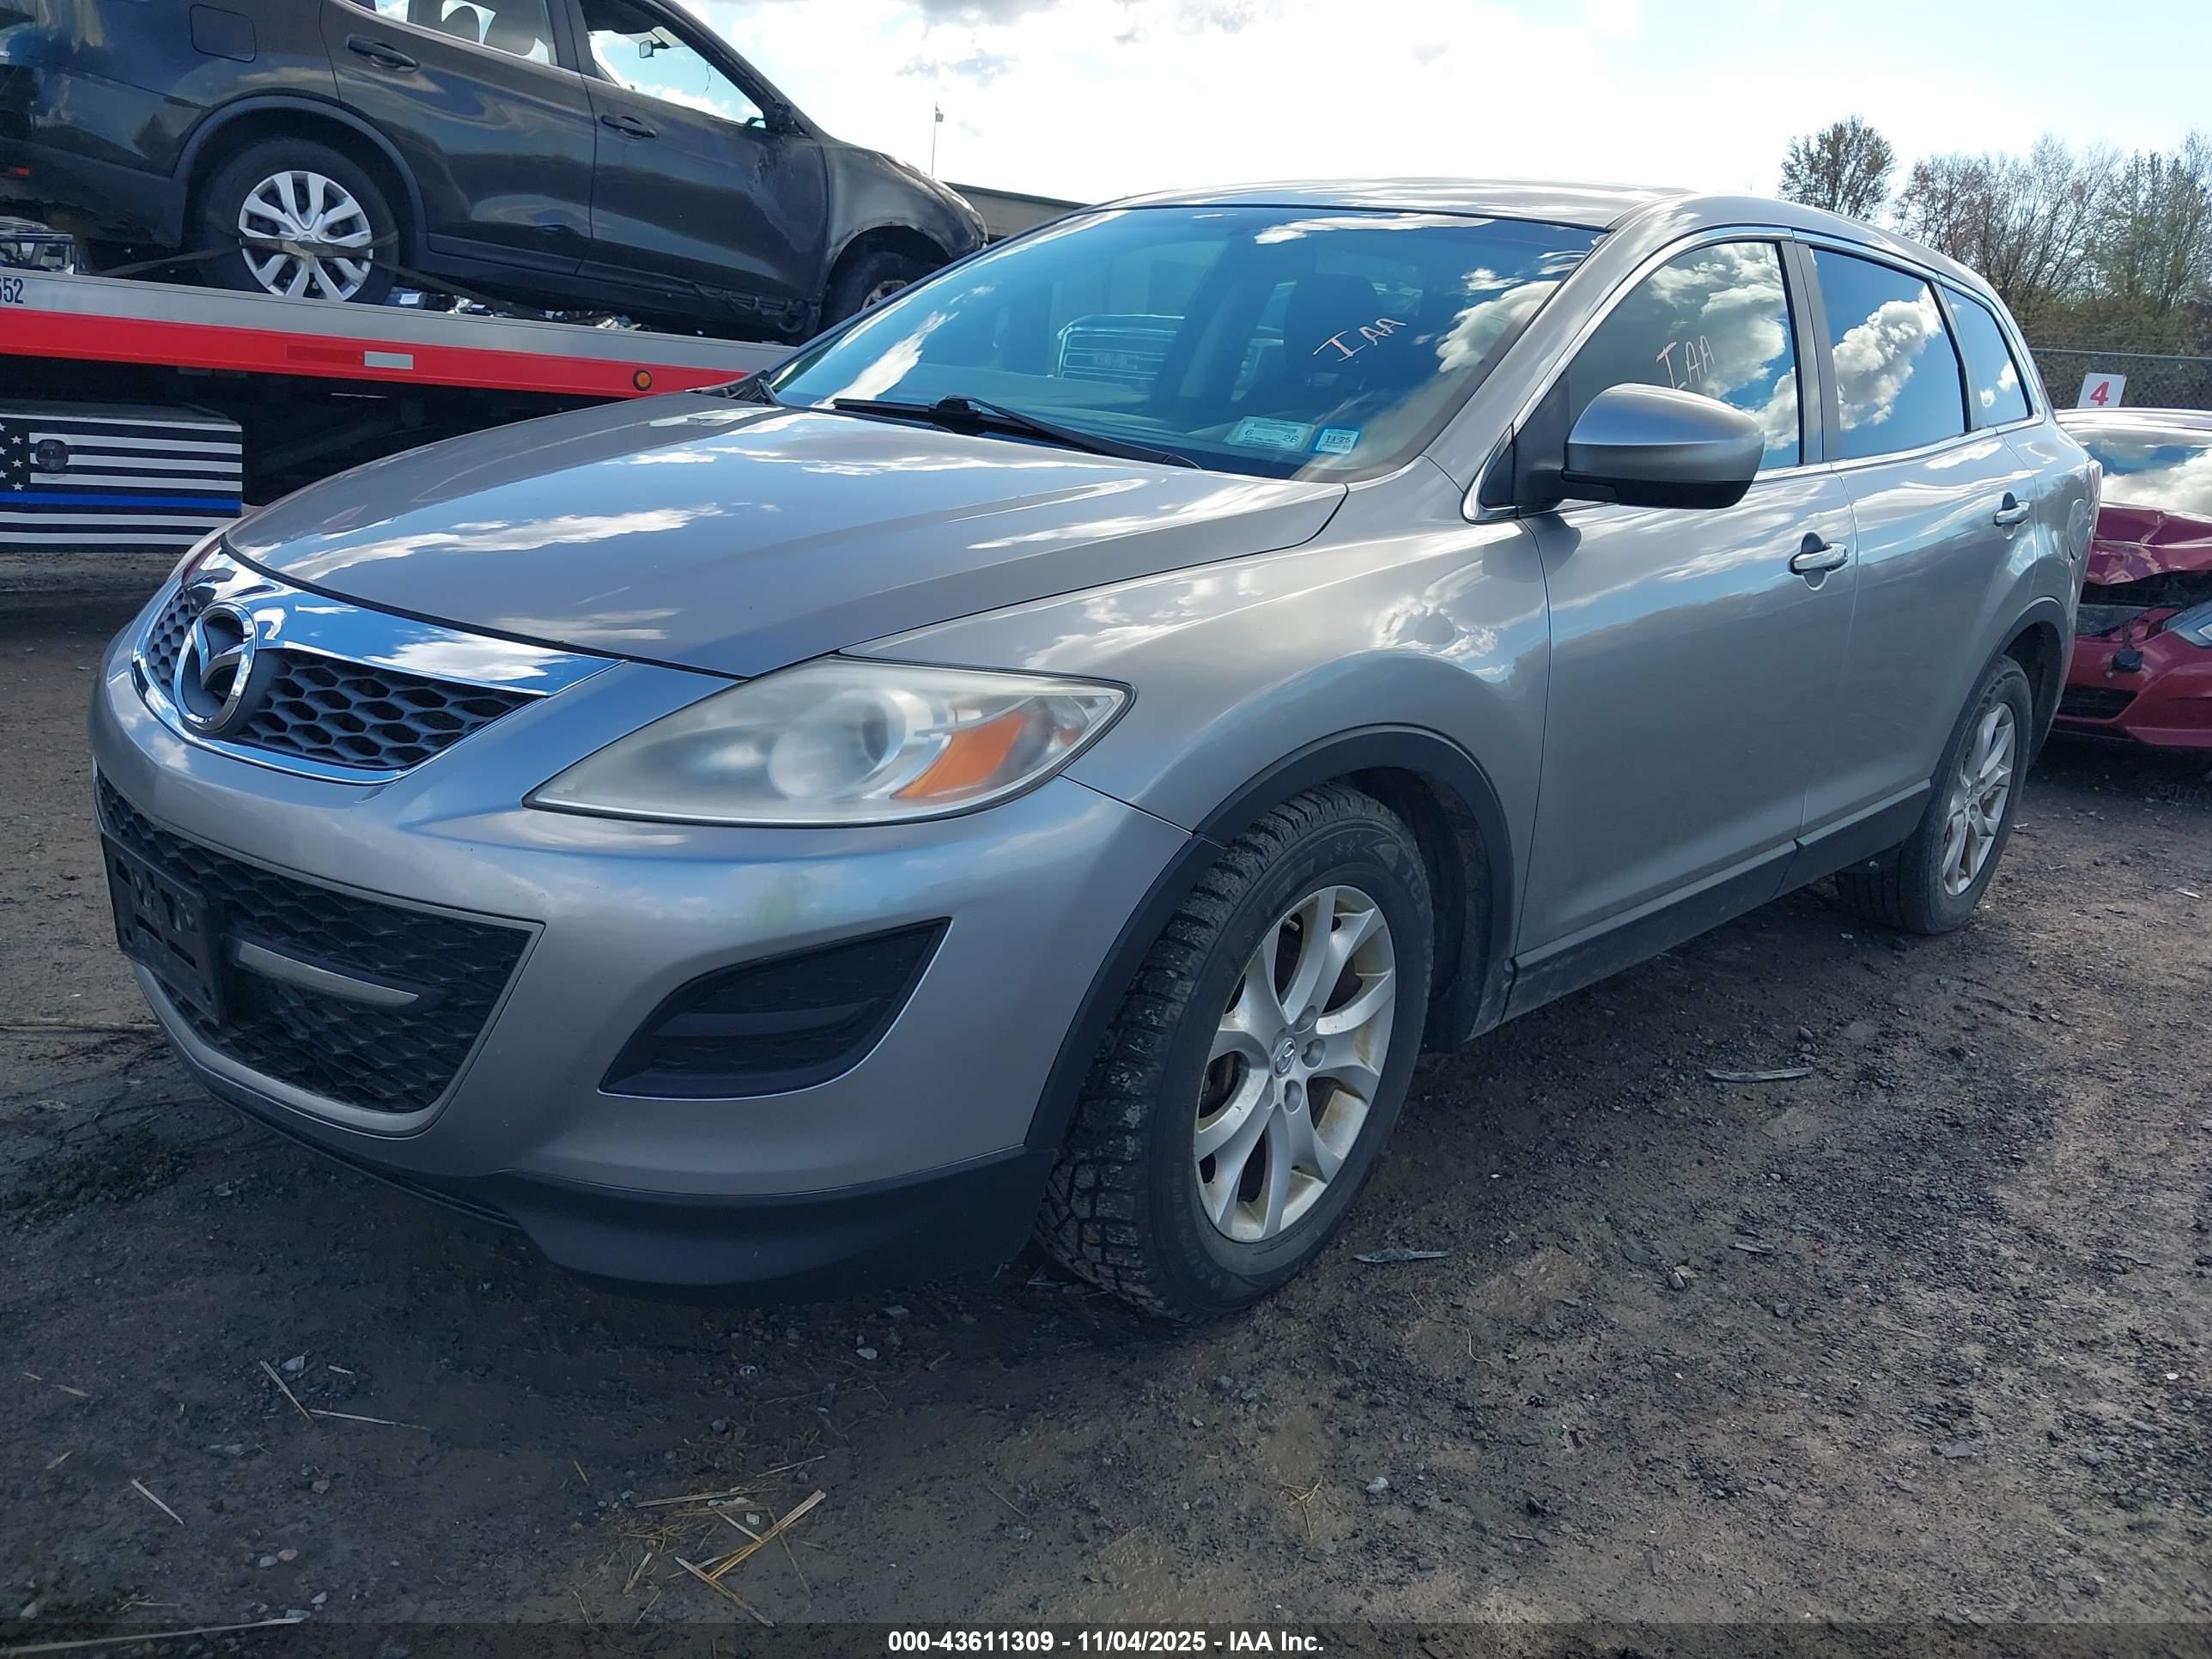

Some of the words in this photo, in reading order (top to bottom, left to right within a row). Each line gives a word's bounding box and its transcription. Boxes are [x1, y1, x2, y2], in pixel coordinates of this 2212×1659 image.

[0, 276, 24, 304] 52
[1313, 318, 1407, 362] IAA
[1656, 336, 1715, 389] IAA
[2089, 381, 2110, 406] 4
[1284, 434, 1299, 443] 26
